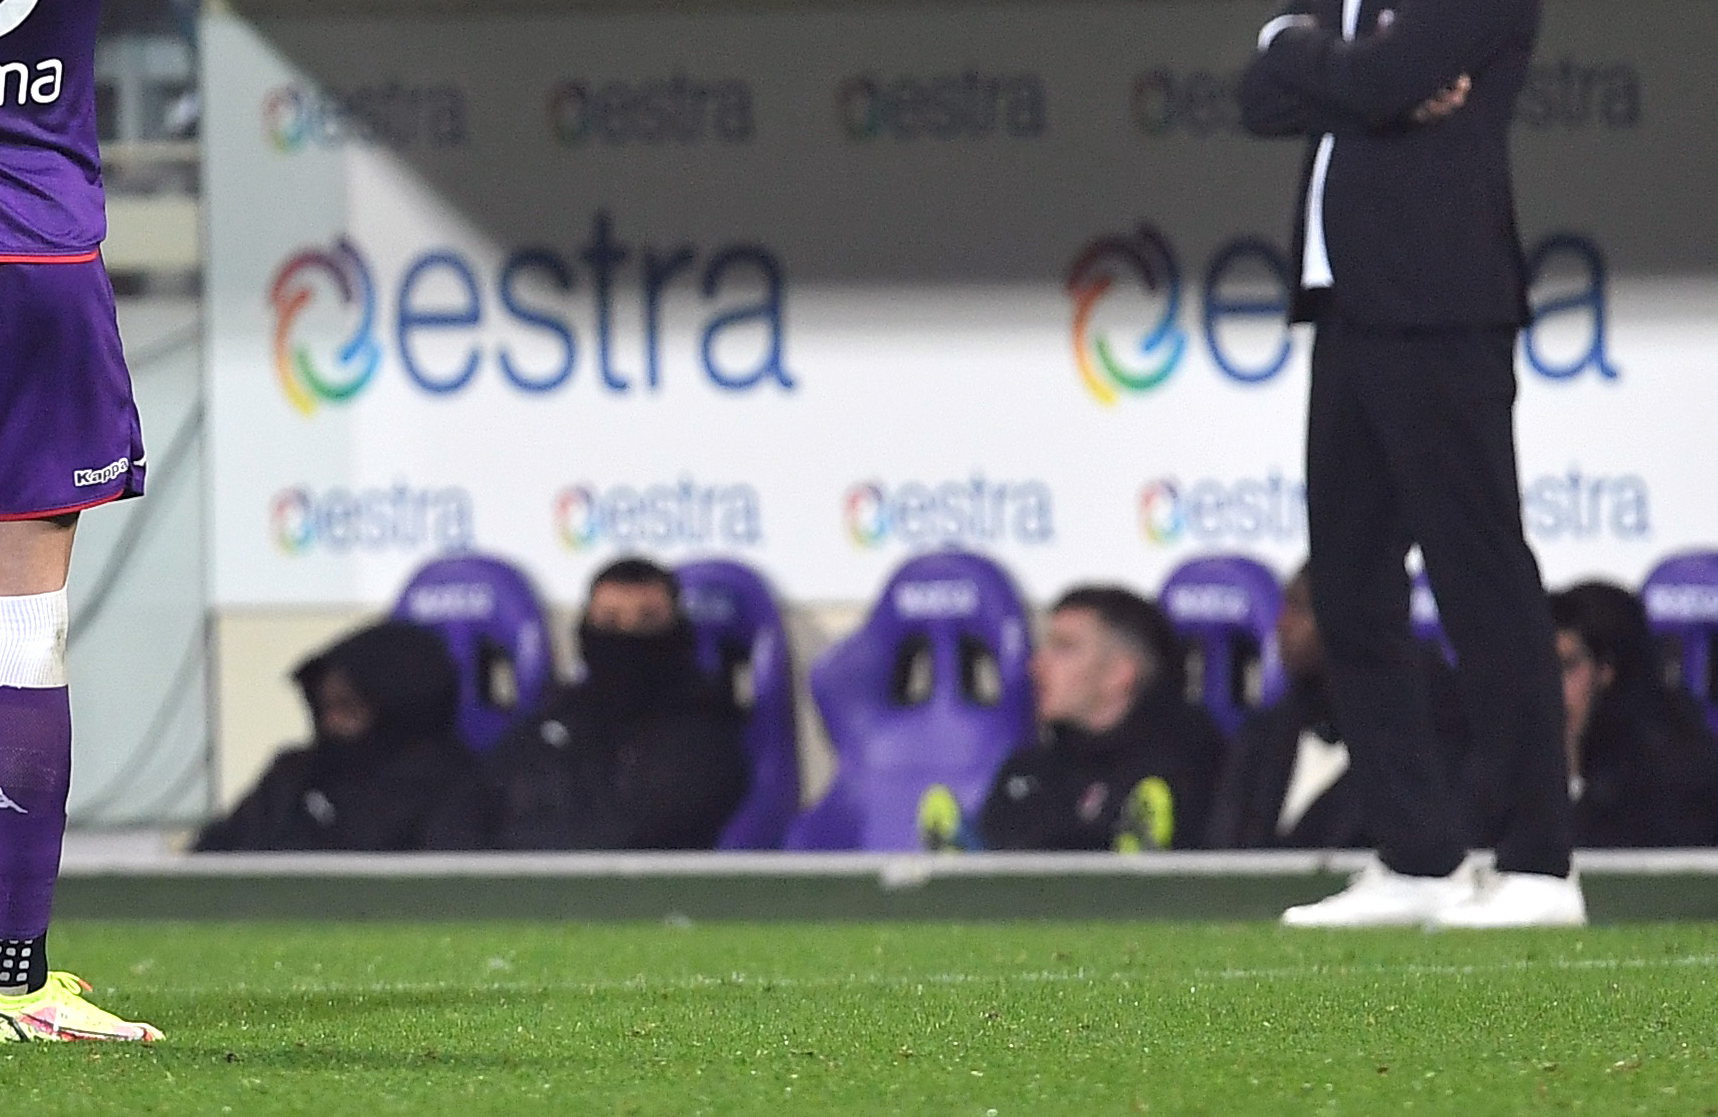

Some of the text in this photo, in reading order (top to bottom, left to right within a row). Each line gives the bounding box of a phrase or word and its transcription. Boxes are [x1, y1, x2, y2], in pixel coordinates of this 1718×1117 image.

[1527, 58, 1642, 128] stra
[394, 208, 800, 398] estra
[74, 458, 130, 486] Kappa
[894, 470, 1054, 542] estra
[1190, 468, 1308, 540] estr
[1520, 464, 1650, 540] stra
[319, 476, 475, 550] estra
[602, 474, 762, 546] estra
